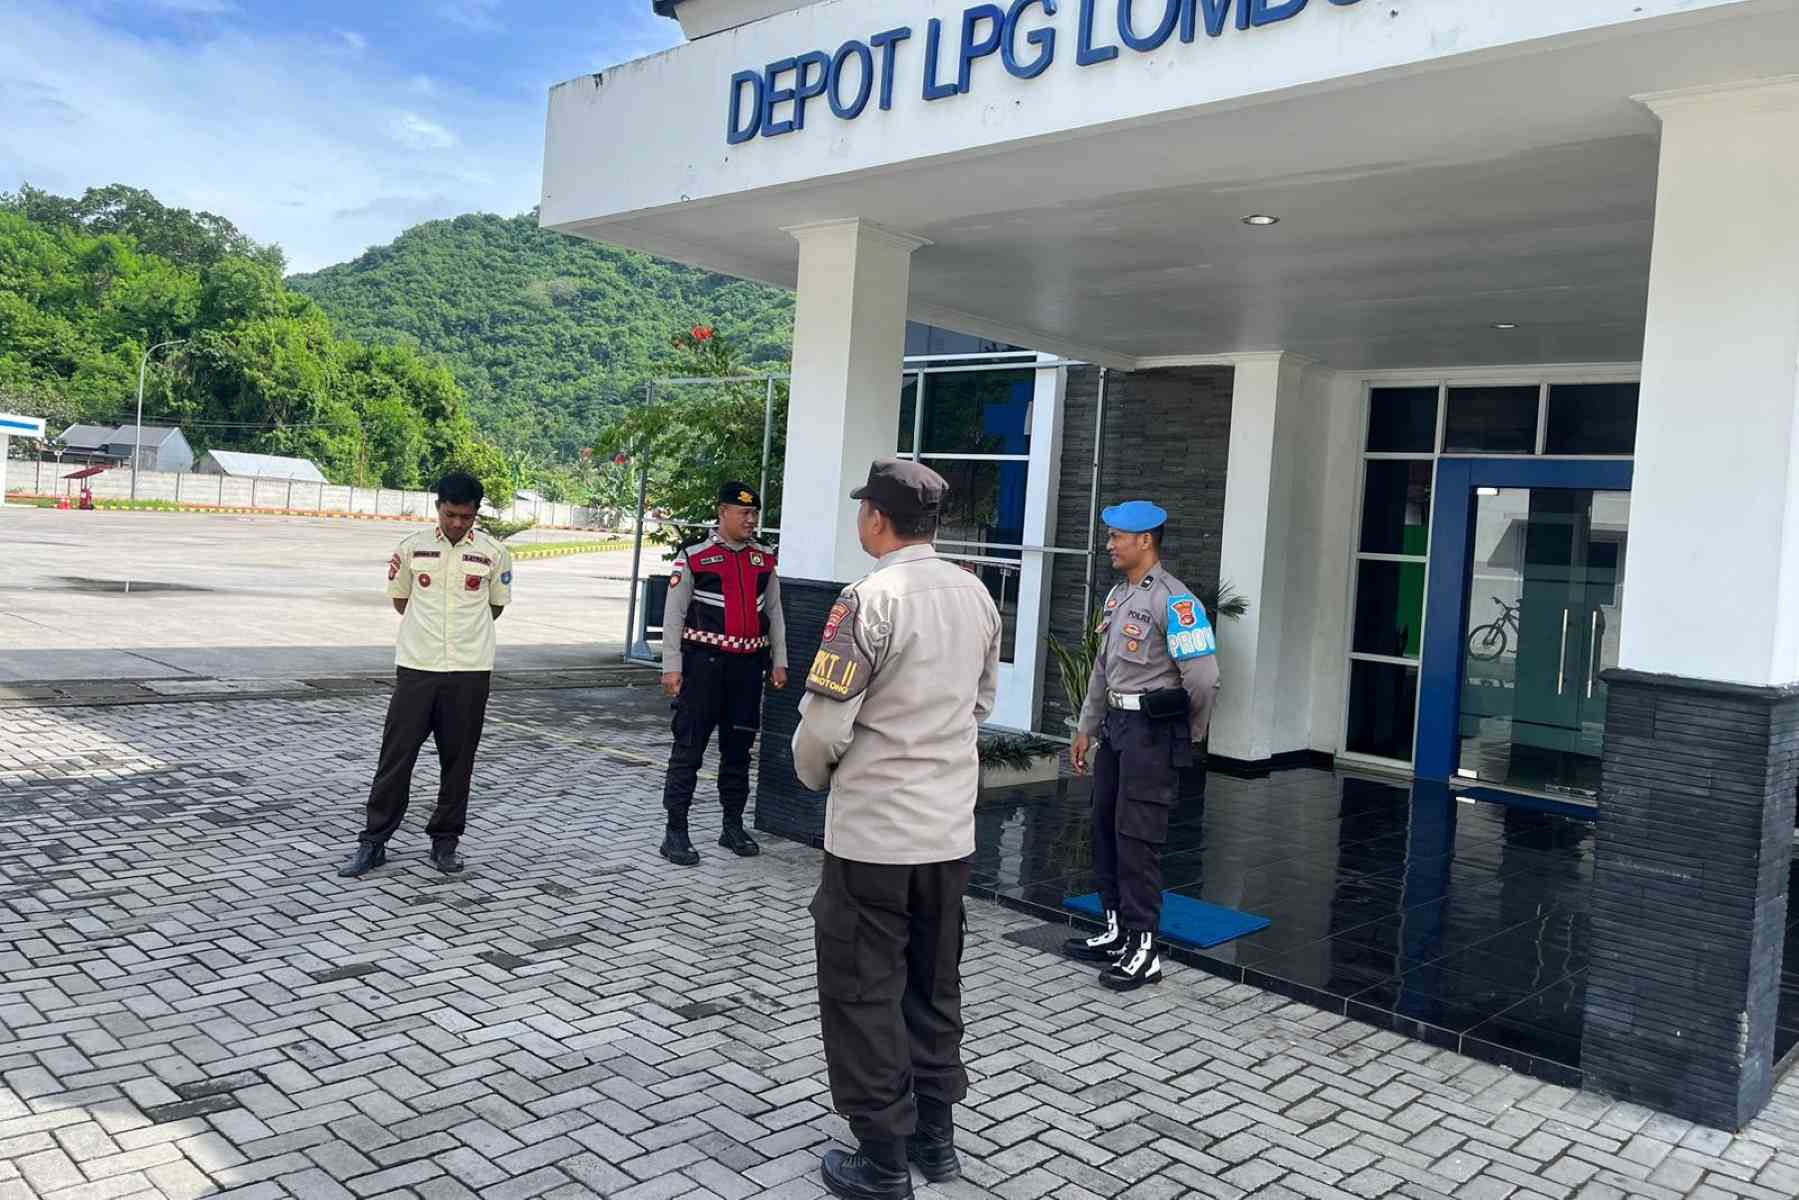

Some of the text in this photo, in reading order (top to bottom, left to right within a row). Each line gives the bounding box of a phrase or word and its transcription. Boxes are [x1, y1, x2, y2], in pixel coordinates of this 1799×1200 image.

[727, 0, 1362, 145] DEPOT LPG LOM
